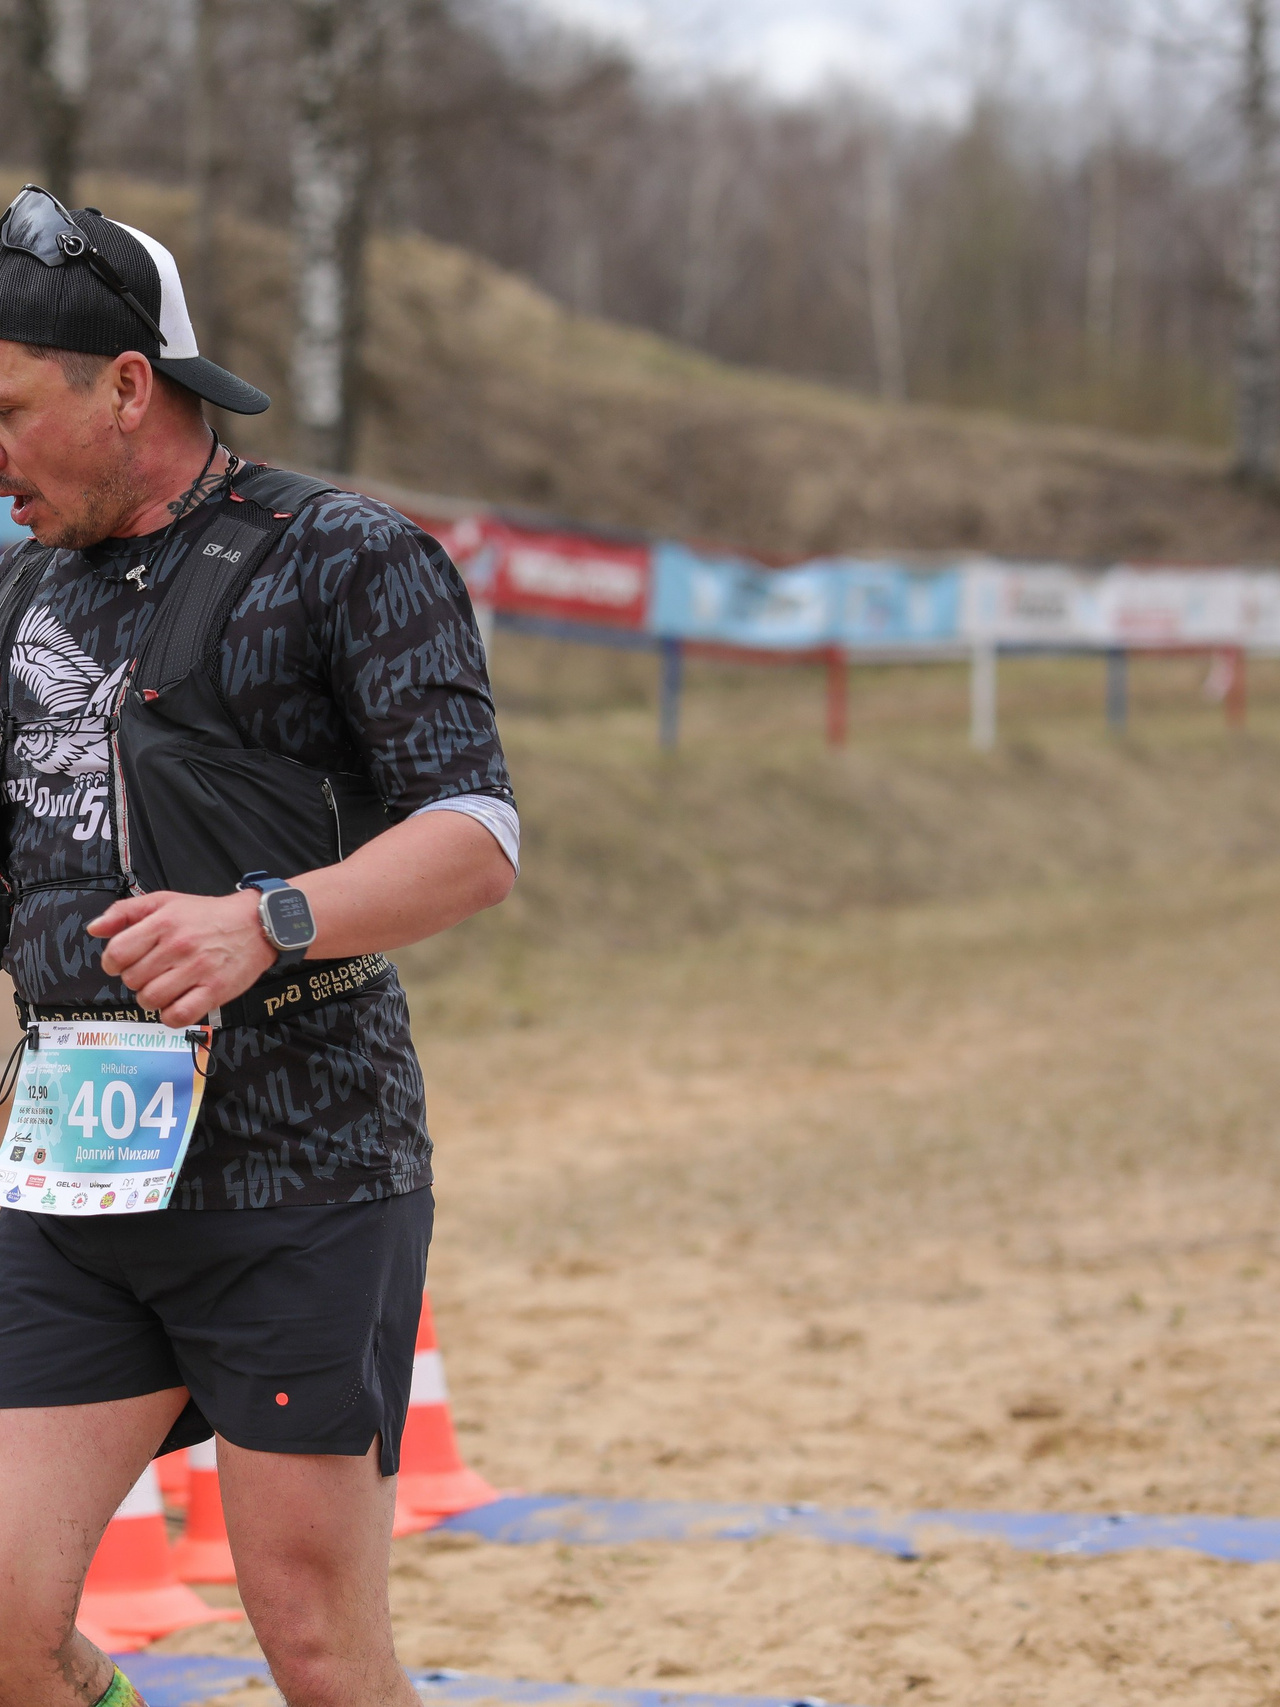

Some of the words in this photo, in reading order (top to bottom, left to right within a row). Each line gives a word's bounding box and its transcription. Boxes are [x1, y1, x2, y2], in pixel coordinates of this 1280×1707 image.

[312, 980, 354, 1001] ULTRA
[76, 1031, 166, 1048] ХИМКИНСКИЙ
[101, 1063, 138, 1075] RHRultras
[28, 1086, 48, 1100] 12,90
[67, 1080, 178, 1140] 404
[75, 1145, 115, 1163] Долгий
[118, 1147, 160, 1161] Михаил
